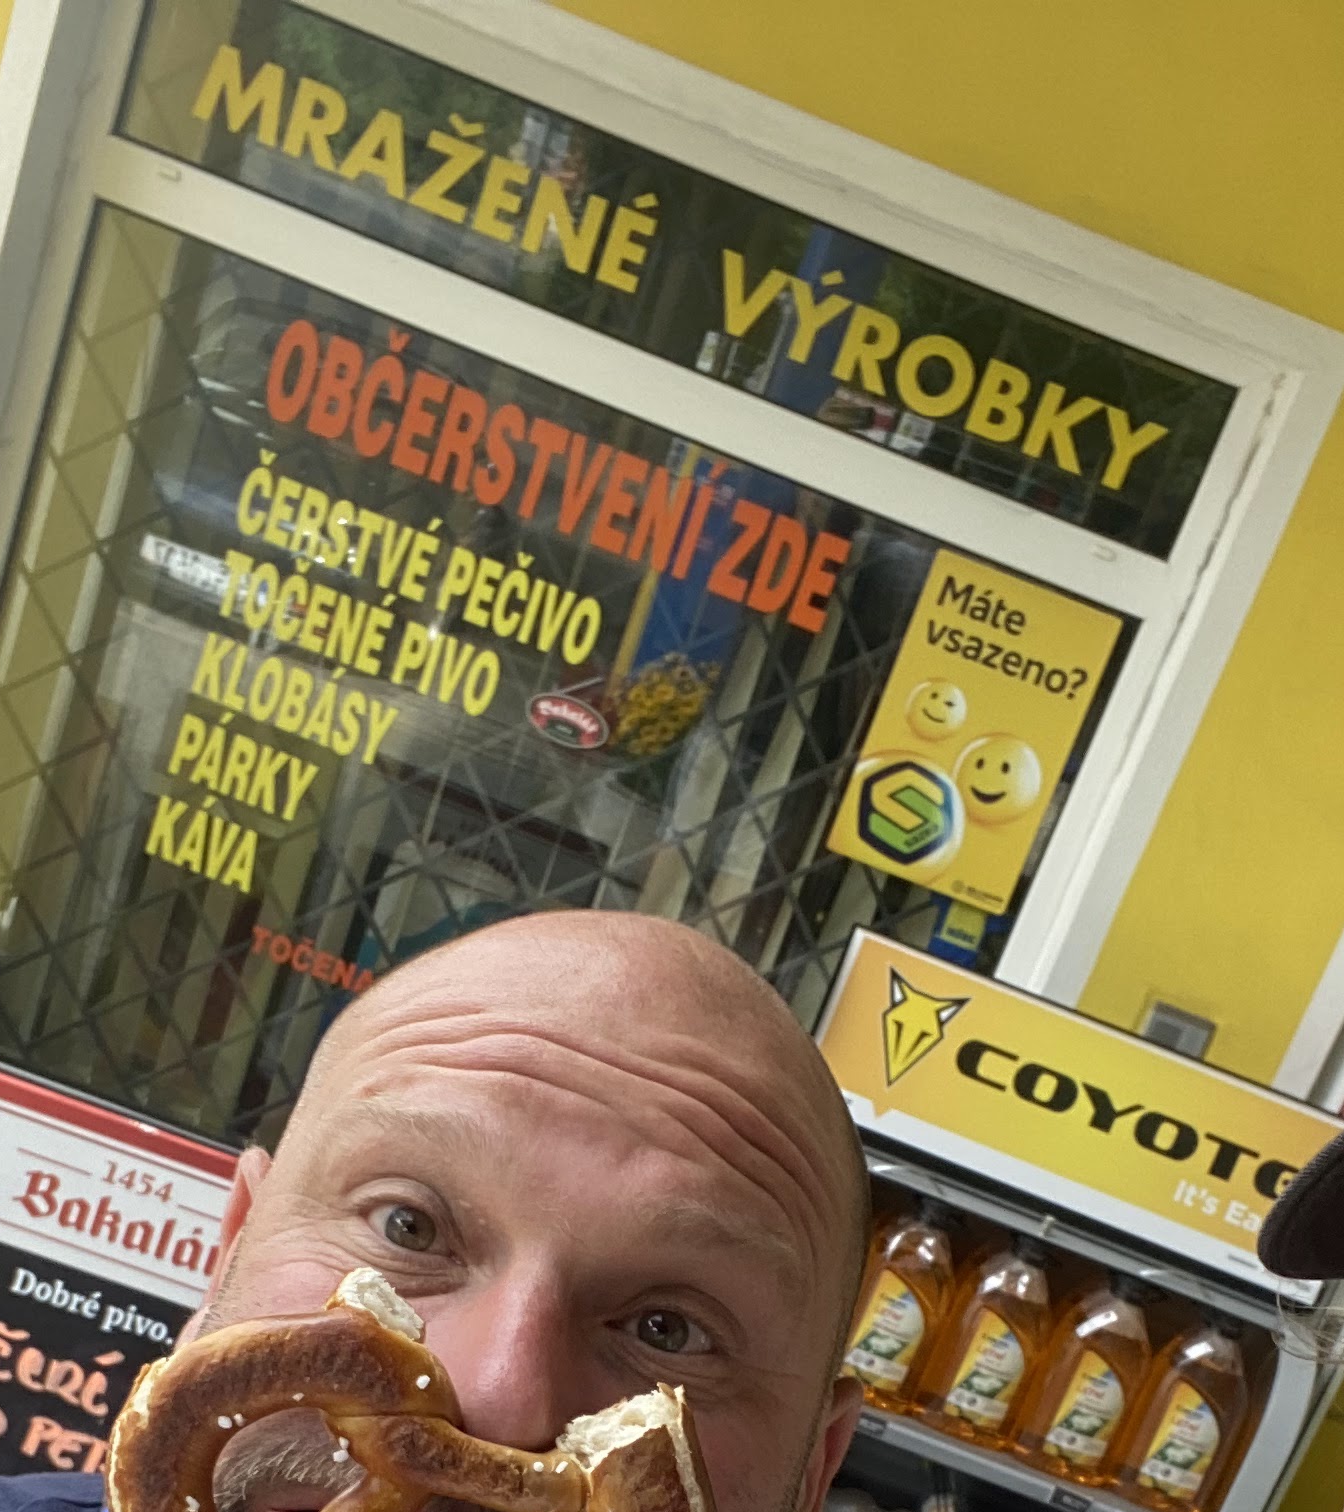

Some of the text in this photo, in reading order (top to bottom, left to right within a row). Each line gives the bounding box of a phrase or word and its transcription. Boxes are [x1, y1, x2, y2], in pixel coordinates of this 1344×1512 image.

[192, 45, 1170, 490] MRAŽENÉ VÝROBKY
[266, 319, 850, 634] OBČERSTVENÍ ZDE
[236, 449, 443, 602] ČERSTVÉ
[436, 547, 603, 665] PEČIVO
[935, 575, 1026, 636] Máte
[218, 549, 394, 676] TOČENÉ
[392, 622, 500, 716] PIVO
[927, 622, 1088, 699] vsazeno?
[192, 632, 399, 765] KLOBÁSY
[169, 711, 319, 821] PÁRKY
[145, 795, 258, 893] KÁVA
[103, 1160, 174, 1203] 1454
[1174, 1178, 1219, 1216] It's
[10, 1267, 173, 1344] Dobré pivo.
